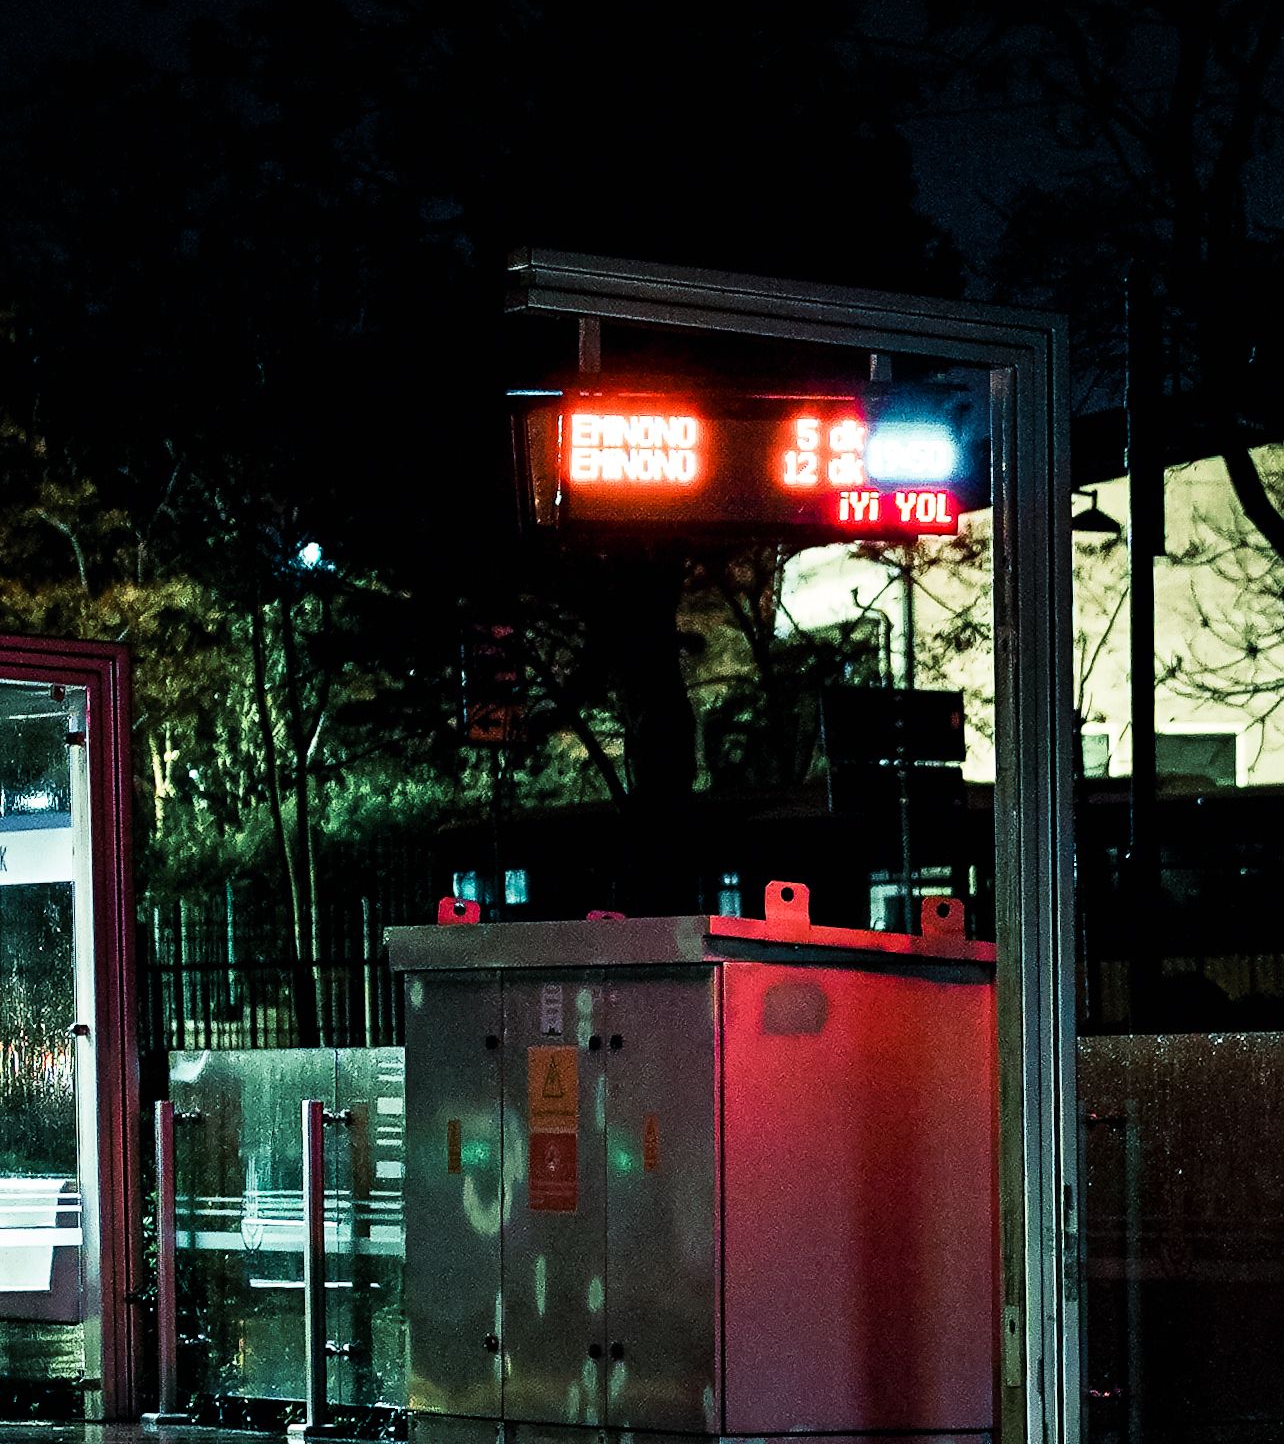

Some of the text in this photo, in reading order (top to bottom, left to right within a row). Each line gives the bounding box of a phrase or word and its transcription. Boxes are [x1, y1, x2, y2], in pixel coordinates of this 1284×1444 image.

[796, 418, 819, 450] 5
[784, 451, 818, 484] 12
[896, 492, 952, 522] YOL
